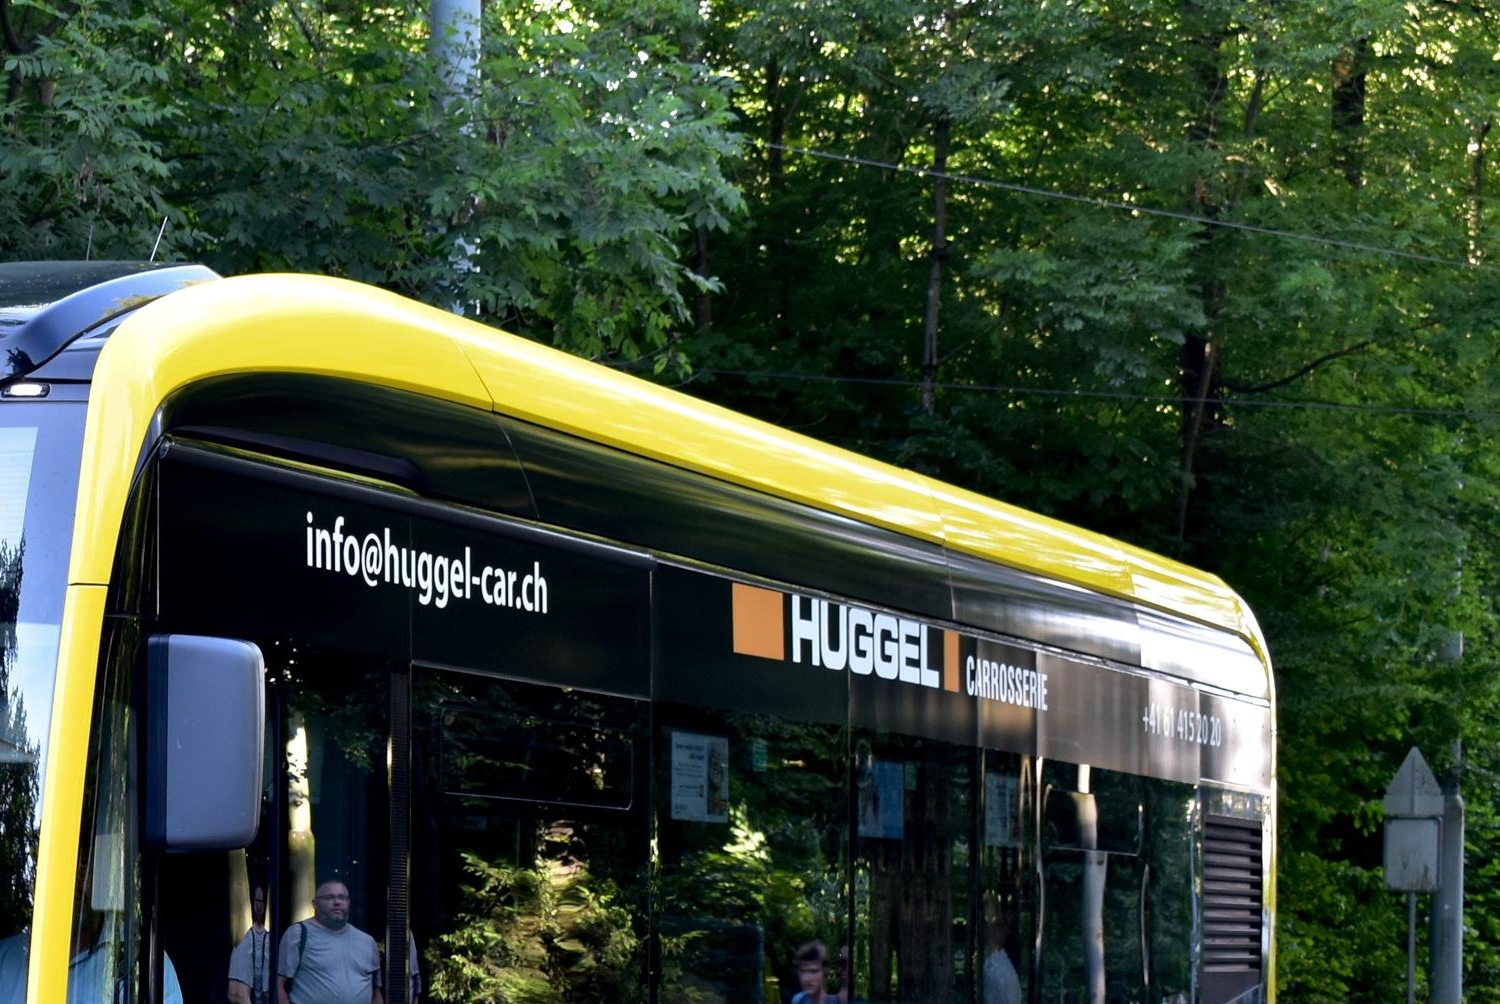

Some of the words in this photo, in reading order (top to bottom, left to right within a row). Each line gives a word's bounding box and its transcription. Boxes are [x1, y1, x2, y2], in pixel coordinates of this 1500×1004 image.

[306, 511, 548, 614] info@huggel-car.ch
[791, 593, 940, 688] HUGGEL
[966, 655, 1048, 711] CARROSSERIE
[1142, 703, 1160, 735] +41
[1177, 709, 1195, 742] 415
[1196, 713, 1208, 745] 20
[1210, 716, 1221, 747] 20
